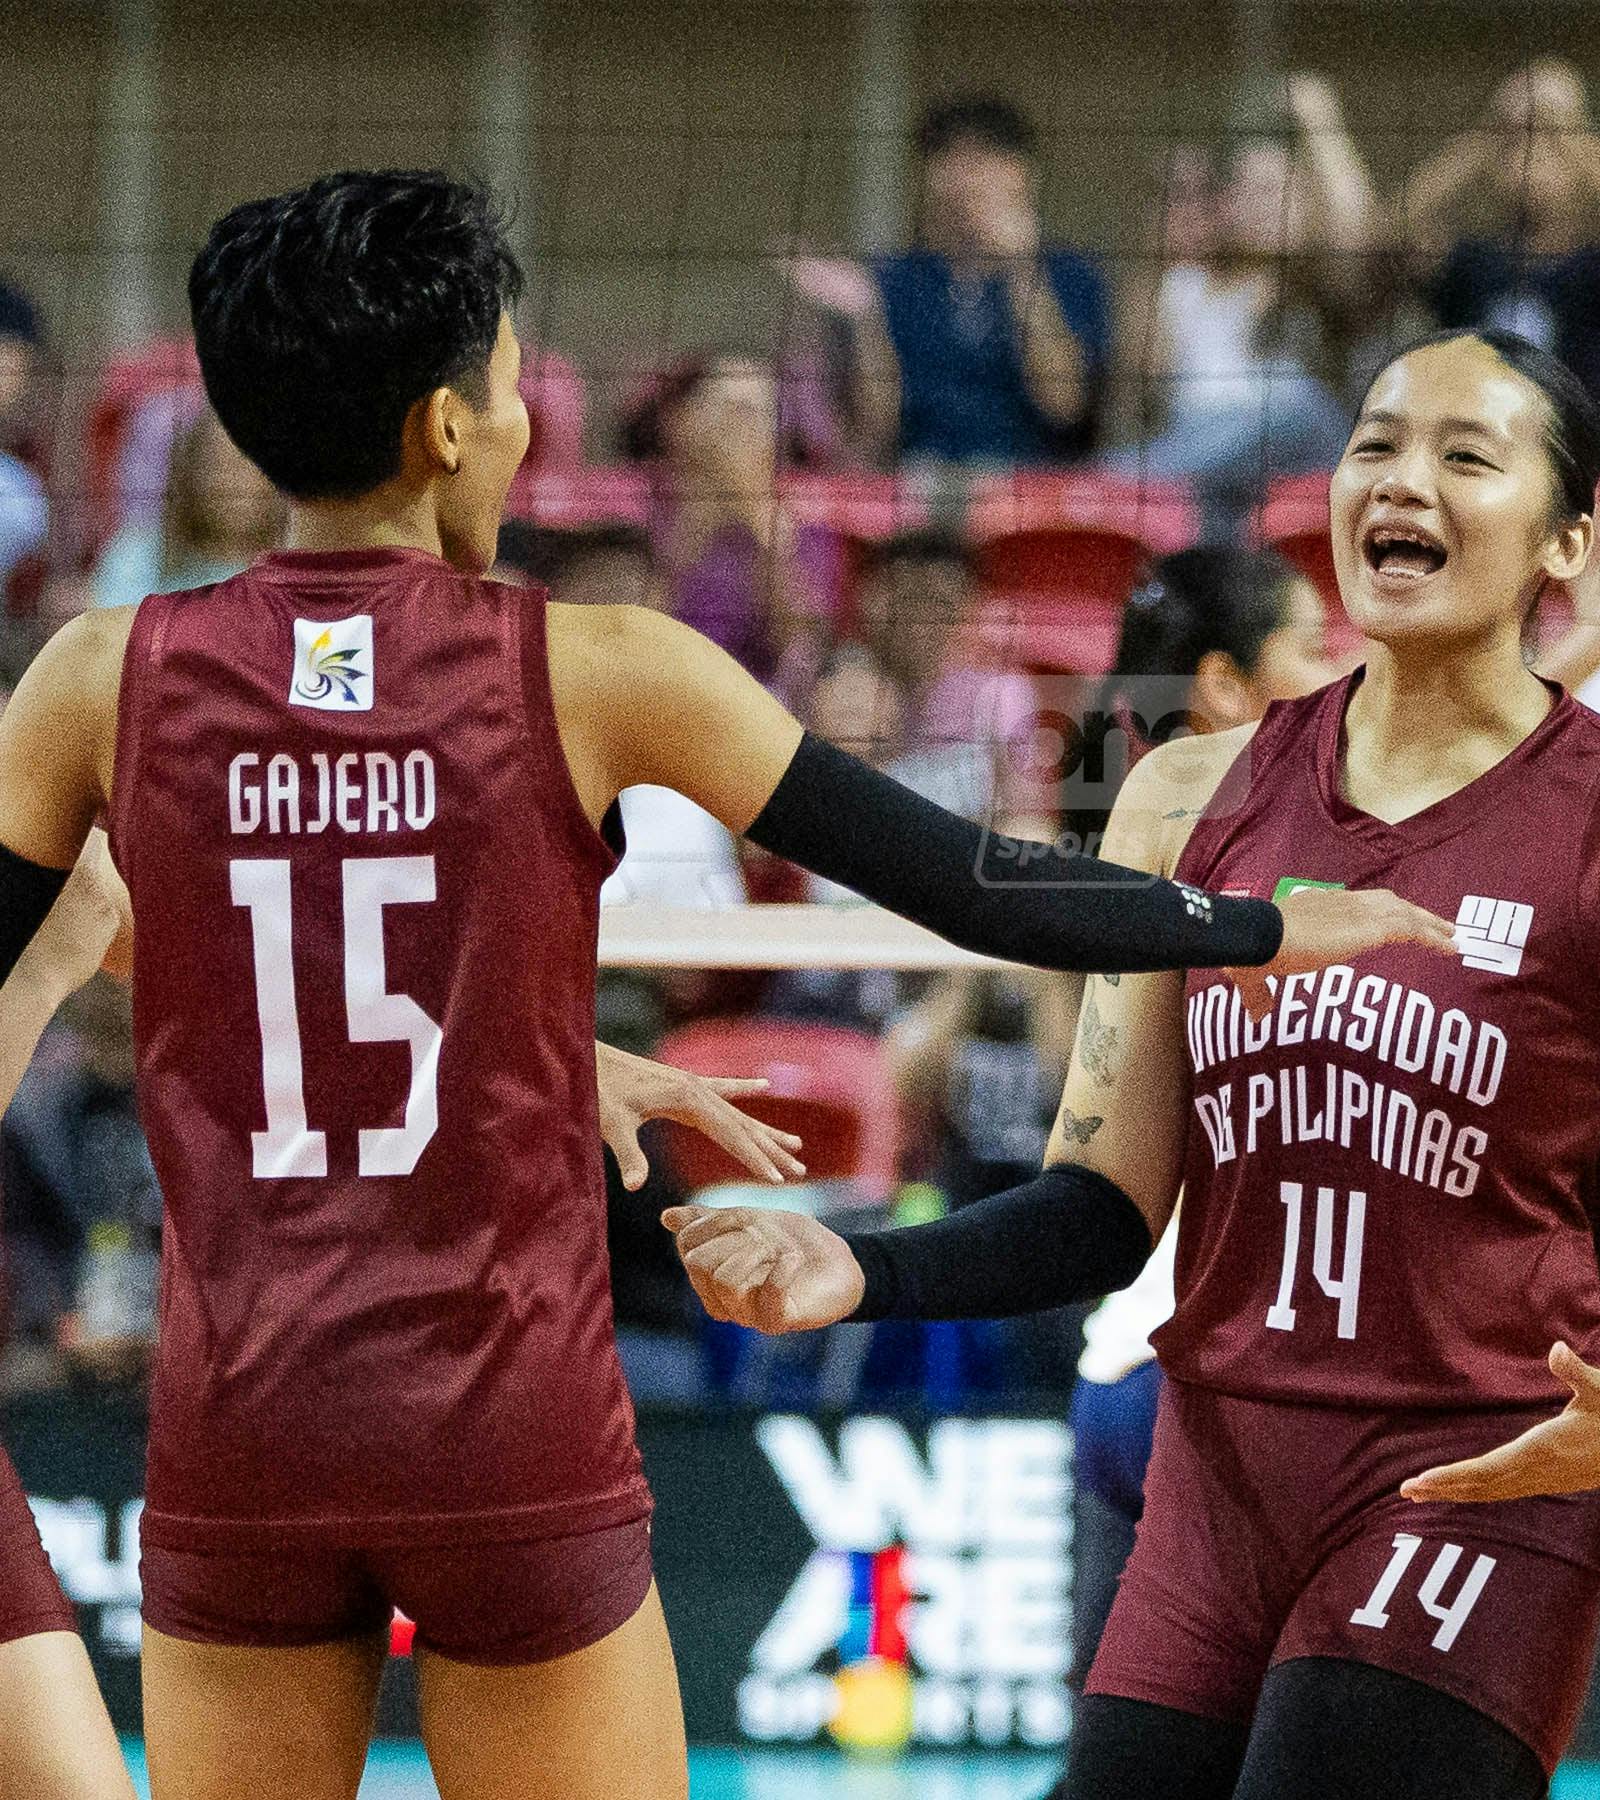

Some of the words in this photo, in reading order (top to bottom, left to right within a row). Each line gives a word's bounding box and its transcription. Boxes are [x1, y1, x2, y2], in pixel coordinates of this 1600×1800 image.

[228, 749, 436, 834] GAJERO
[229, 855, 444, 1179] 15
[1194, 1083, 1237, 1170] DE
[1246, 1063, 1489, 1198] PILIPINAS
[1265, 1181, 1367, 1340] 14
[756, 1415, 1077, 1546] WE
[1349, 1533, 1497, 1652] 14
